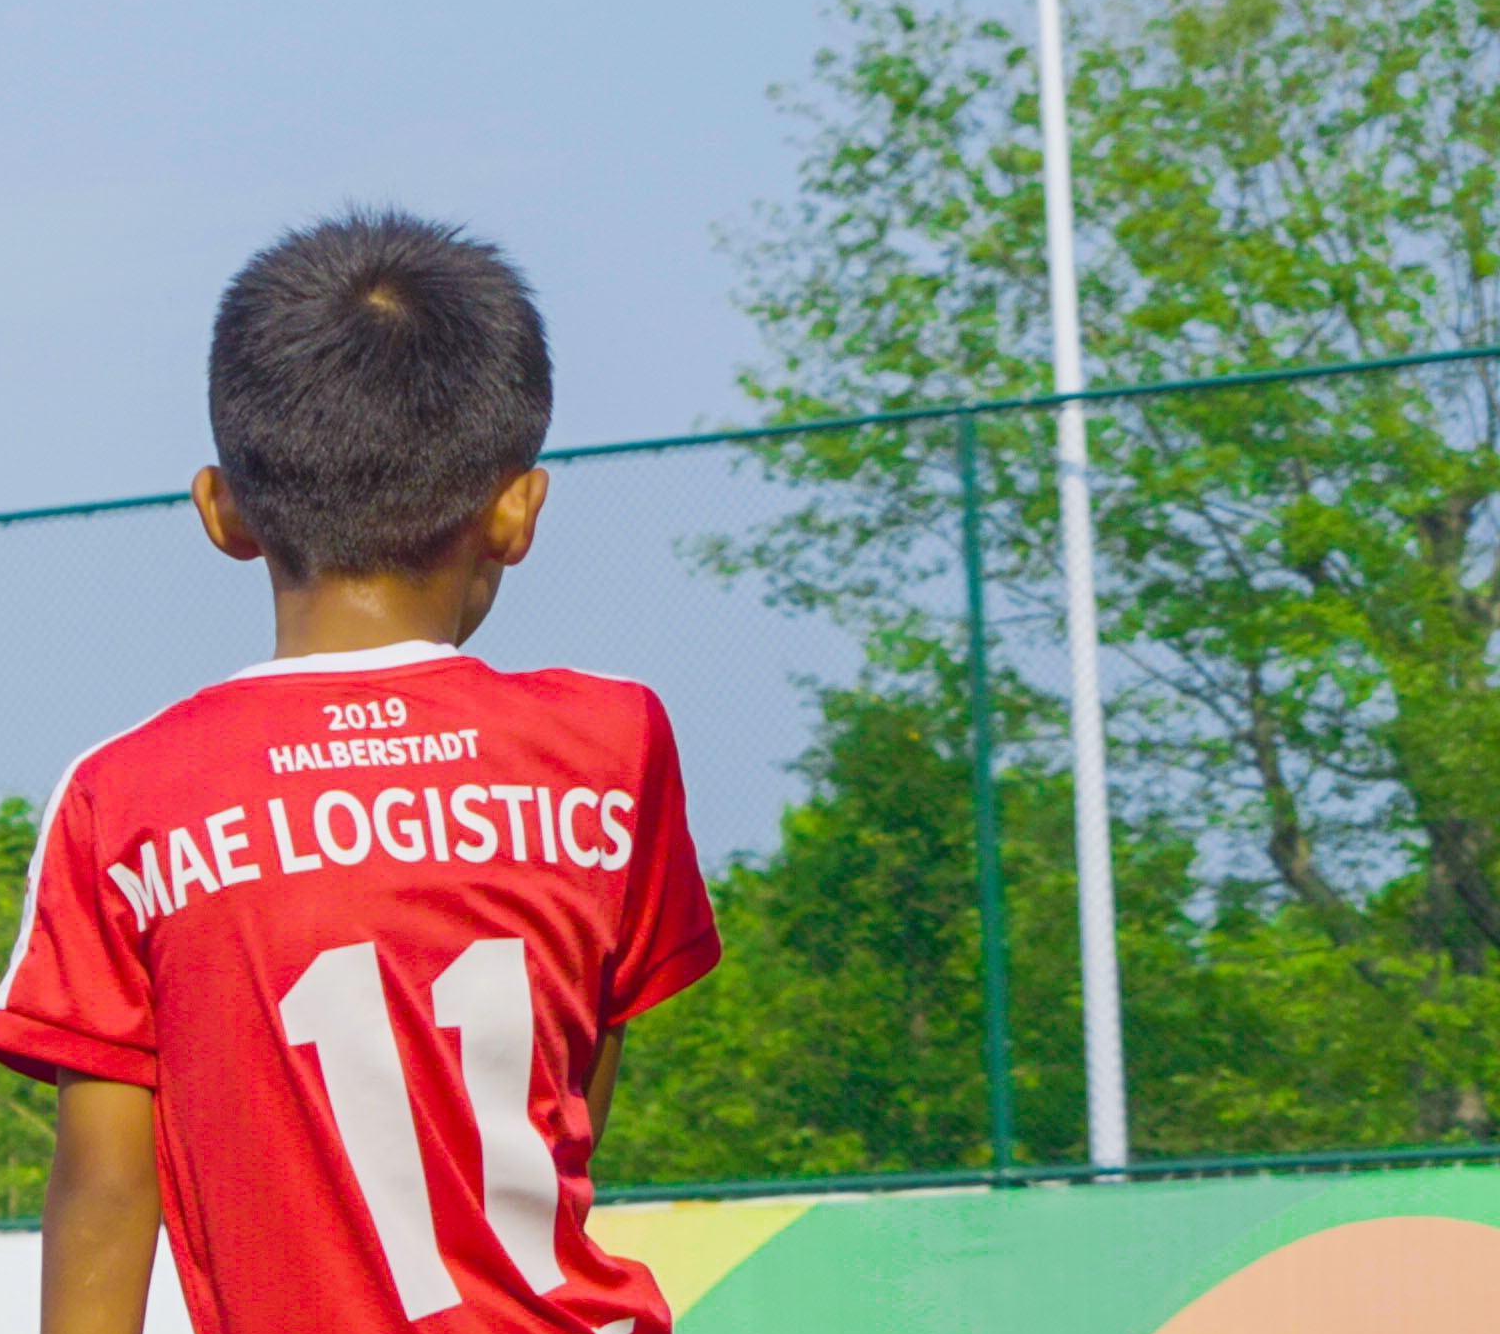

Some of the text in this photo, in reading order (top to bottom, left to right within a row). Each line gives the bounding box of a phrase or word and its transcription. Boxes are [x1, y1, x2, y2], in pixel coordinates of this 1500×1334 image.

[269, 729, 479, 774] HALBERSTADT
[323, 698, 407, 731] 2019
[107, 784, 636, 932] MAE LOGISTICS
[278, 937, 567, 1322] 11
